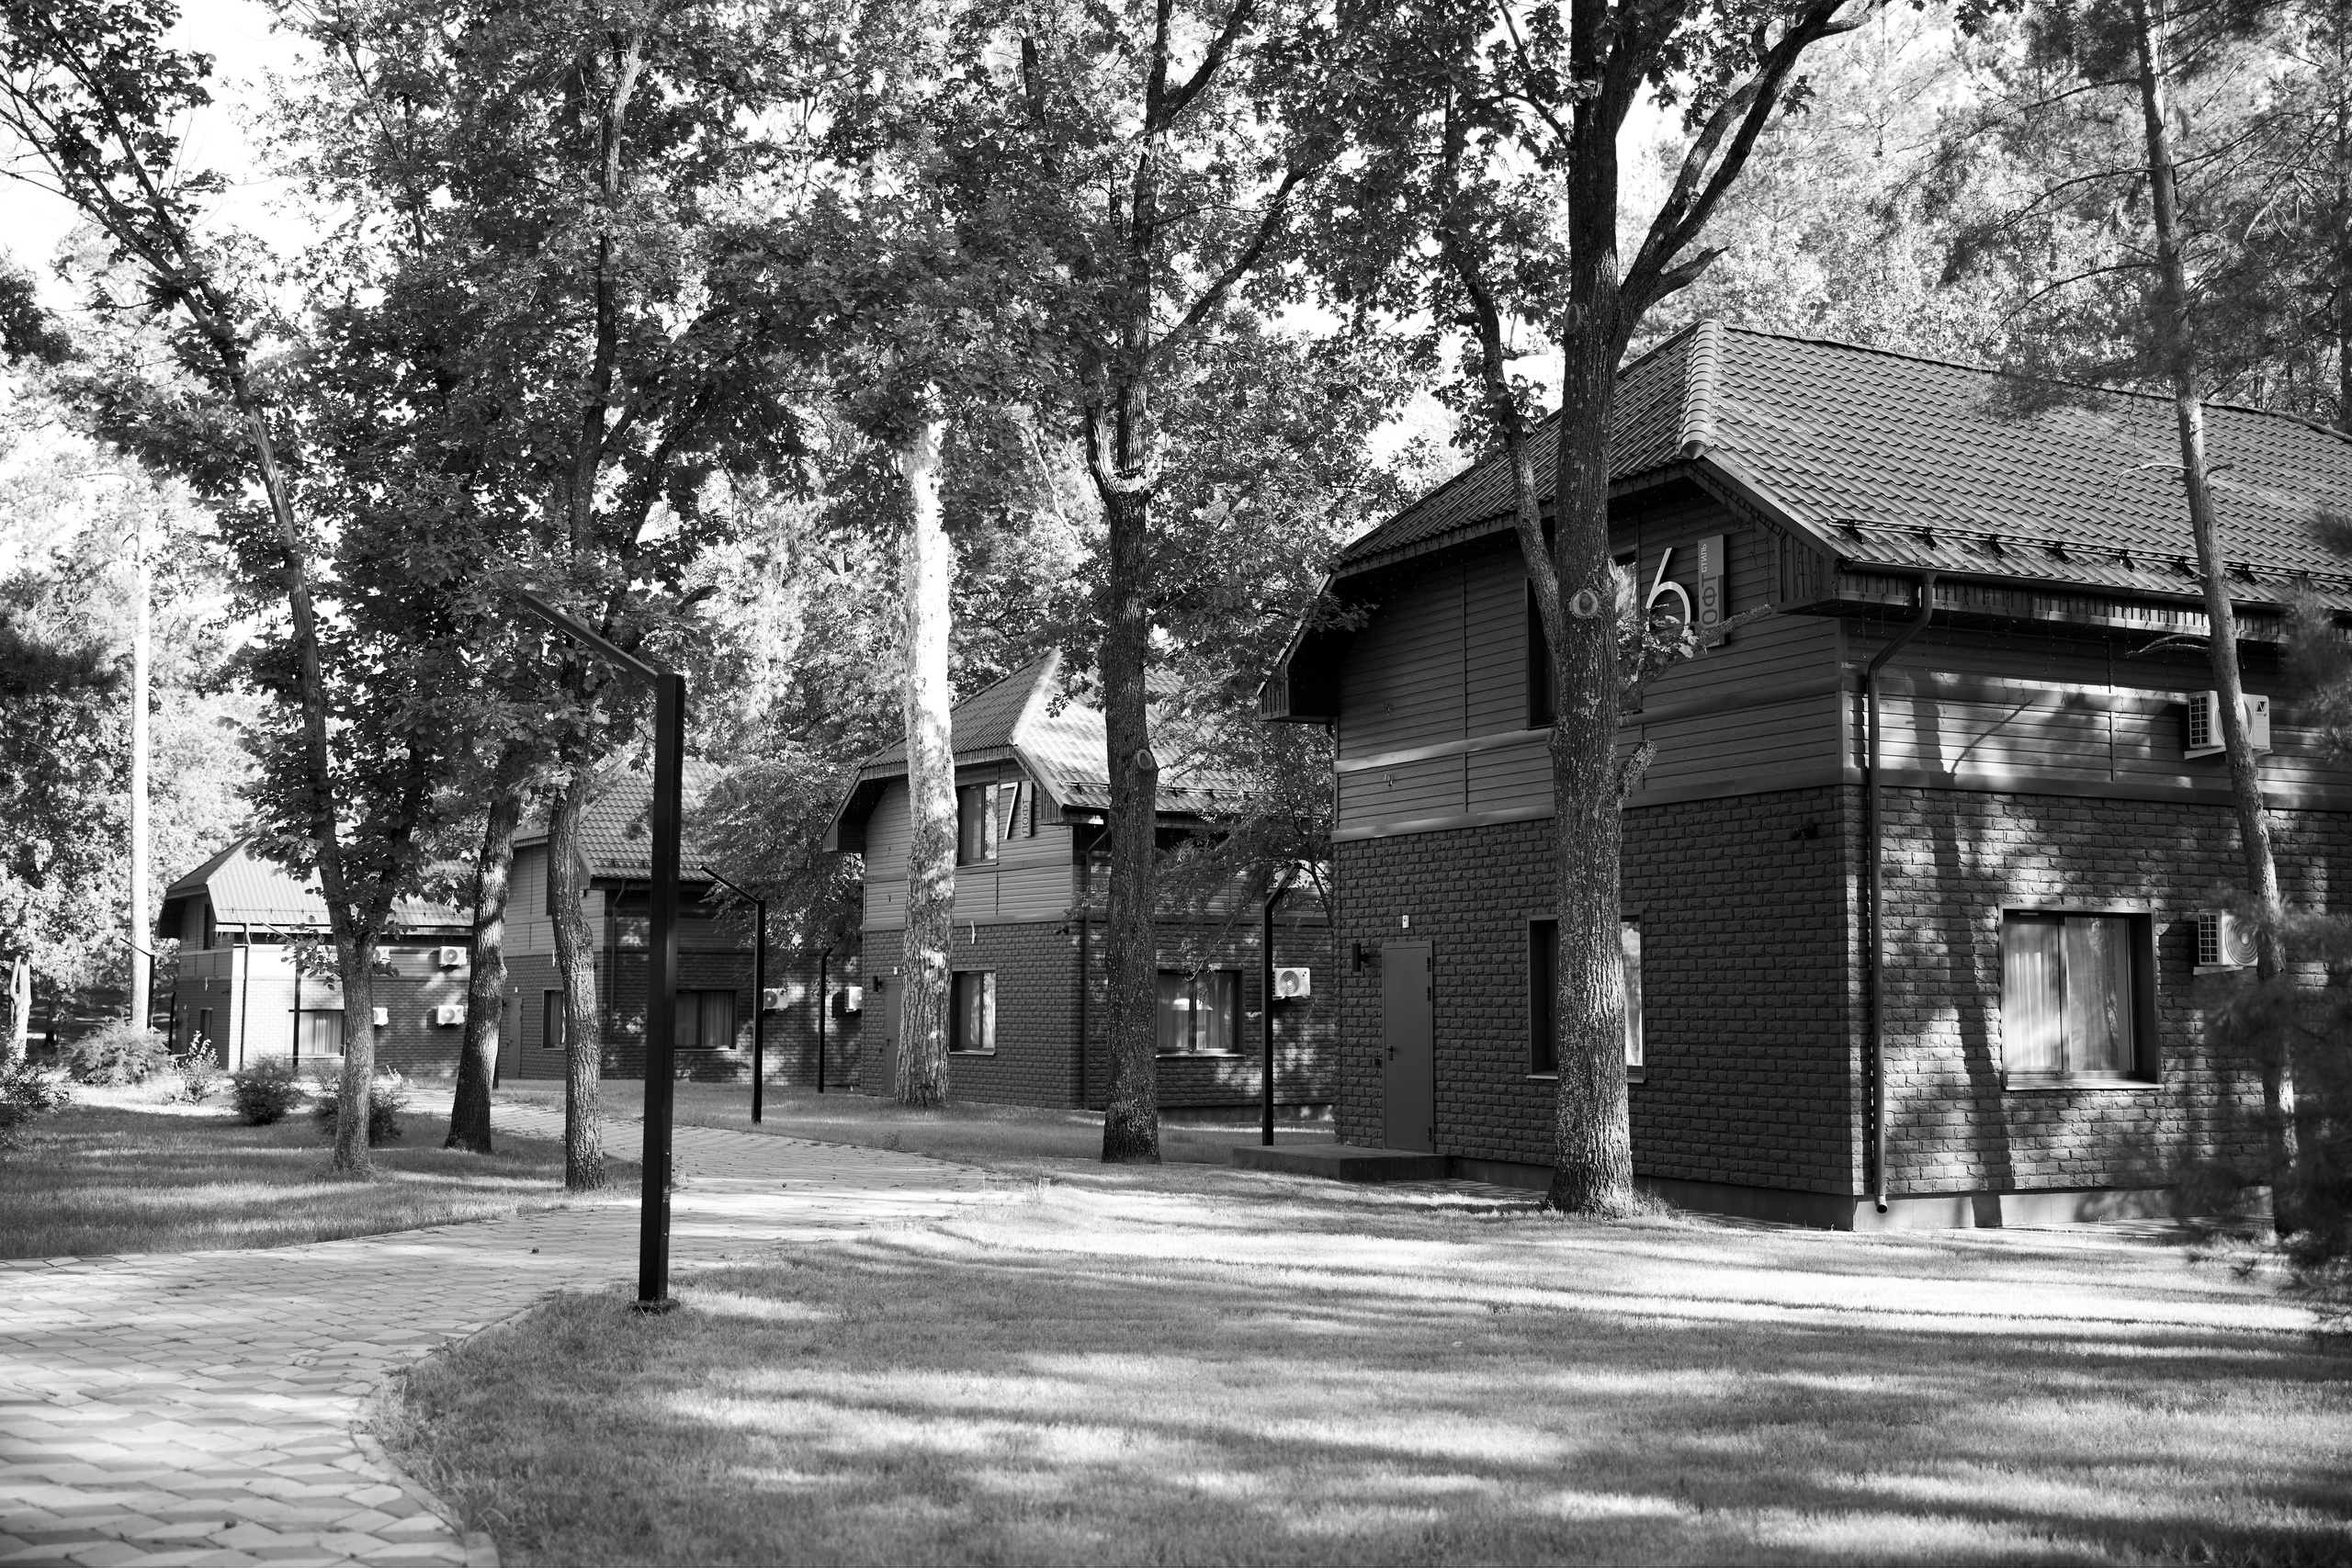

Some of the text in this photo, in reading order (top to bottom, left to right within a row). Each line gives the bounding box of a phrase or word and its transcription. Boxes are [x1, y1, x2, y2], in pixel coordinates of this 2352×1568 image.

[1645, 547, 1691, 645] 6
[1702, 574, 1718, 640] ОФТ
[1001, 782, 1018, 840] 7
